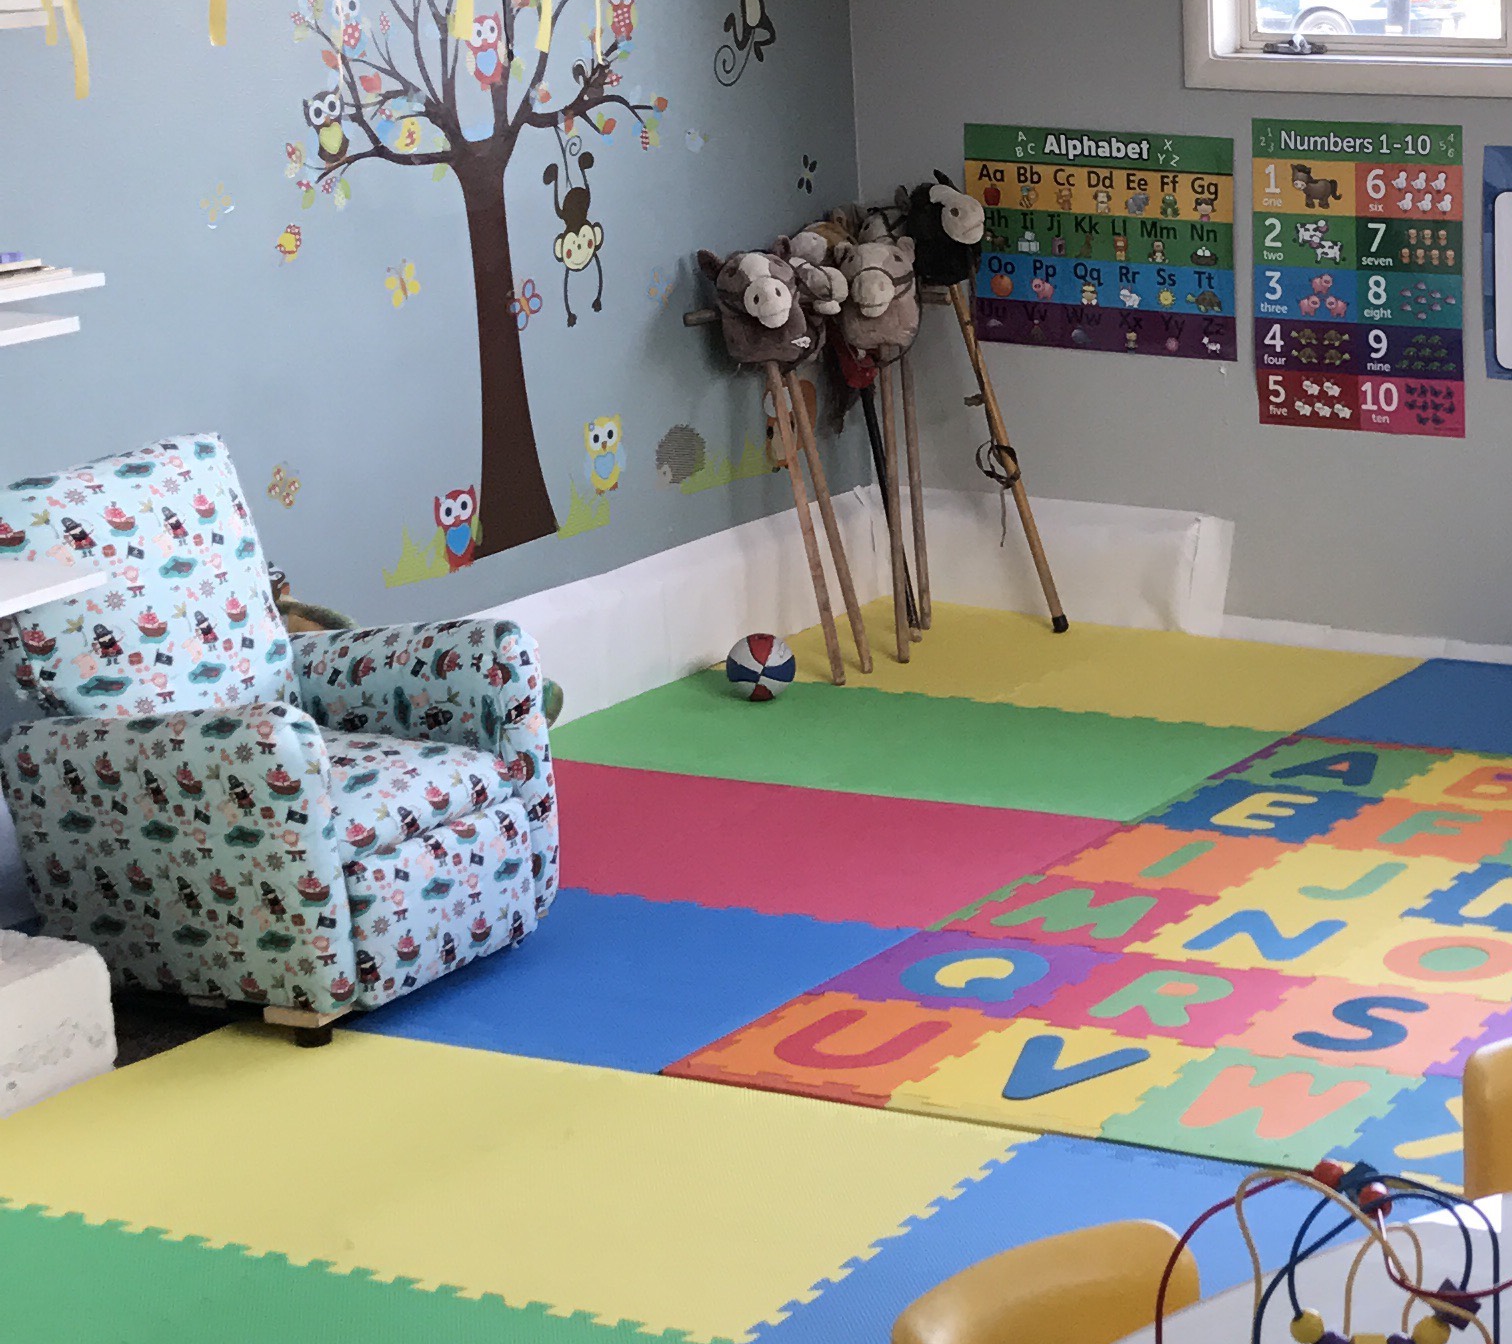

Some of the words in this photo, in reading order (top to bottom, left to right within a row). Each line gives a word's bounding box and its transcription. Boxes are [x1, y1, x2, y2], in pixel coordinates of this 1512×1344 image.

[1044, 135, 1149, 159] Alphabet
[1280, 130, 1373, 154] Numbers
[1379, 133, 1431, 155] 1-10
[978, 164, 1004, 182] Aa
[1017, 166, 1041, 184] Bb
[1053, 169, 1075, 187] Cc
[1087, 171, 1114, 189] Dd
[1126, 173, 1148, 191] Ee
[1160, 175, 1178, 193] Ff
[1191, 177, 1218, 200] Gg
[1265, 164, 1281, 194] 1
[1366, 169, 1386, 198] 6
[1369, 203, 1384, 213] six
[1021, 213, 1034, 230] Ii
[1047, 214, 1061, 237] Jj
[1074, 216, 1099, 234] Kk
[1140, 221, 1177, 240] Mm
[1191, 224, 1217, 242] Nn
[1265, 218, 1282, 248] 2
[1368, 223, 1386, 253] 7
[988, 256, 1015, 275] Oo
[1033, 258, 1056, 280] Pp
[1074, 262, 1103, 286] Qq
[1119, 266, 1140, 284] Rr
[1156, 268, 1176, 286] Ss
[1194, 271, 1214, 289] Tt
[1263, 252, 1283, 261] two
[1361, 256, 1393, 267] seven
[1266, 271, 1282, 300] 3
[1368, 276, 1387, 305] 8
[1260, 302, 1287, 313] three
[1364, 308, 1392, 320] eight
[1264, 324, 1284, 353] 4
[1368, 329, 1388, 359] 9
[1264, 355, 1286, 365] four
[1367, 362, 1391, 372] nine
[1269, 375, 1286, 404] 5
[1361, 382, 1398, 412] 10
[1270, 405, 1287, 416] five
[1372, 414, 1389, 424] ten
[1271, 752, 1378, 785] A
[1211, 792, 1319, 829] E
[1378, 811, 1485, 843] F
[1299, 862, 1406, 901] J
[991, 889, 1158, 939] M
[1183, 909, 1346, 961] N
[900, 948, 1050, 1002] Q
[1089, 970, 1234, 1027] R
[1292, 996, 1429, 1051] S
[774, 1009, 952, 1069] U
[1001, 1035, 1151, 1101] V
[1179, 1065, 1371, 1138] W
